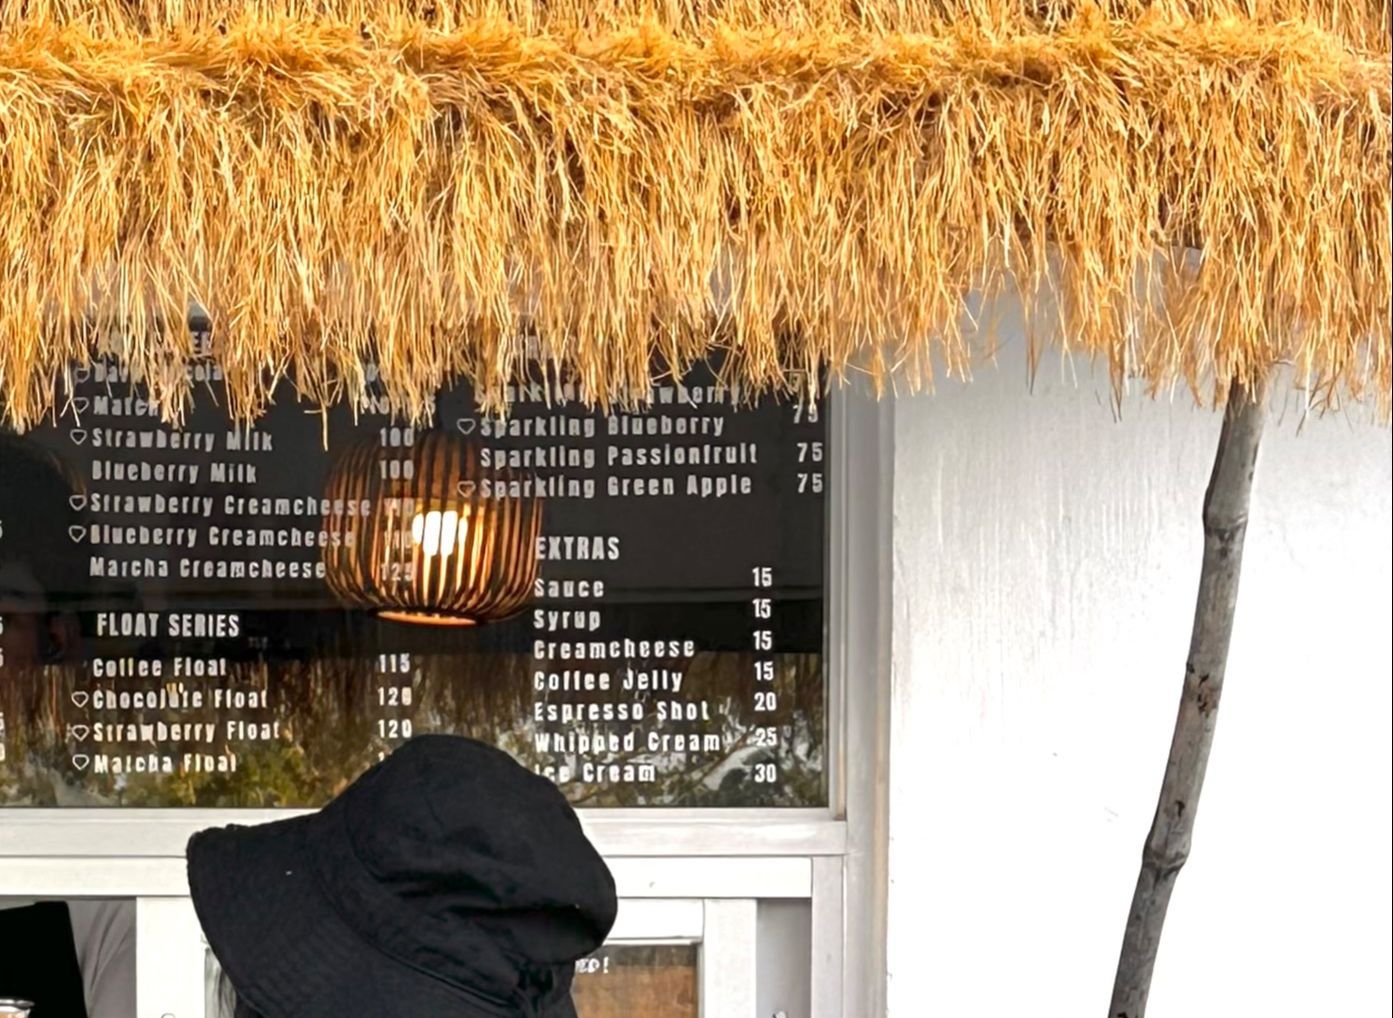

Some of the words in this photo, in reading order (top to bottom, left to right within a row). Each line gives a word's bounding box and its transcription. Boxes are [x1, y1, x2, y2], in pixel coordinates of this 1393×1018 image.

[480, 416, 595, 437] Sparkling
[608, 414, 724, 436] Blueberry
[92, 429, 214, 452] Strawberry
[226, 432, 272, 452] Milk
[380, 427, 414, 446] 100
[480, 448, 595, 468] Sparkling
[608, 444, 758, 466] Passionfruit
[797, 443, 824, 462] 75
[92, 461, 198, 484] Blueberry
[210, 464, 257, 483] Milk
[379, 459, 414, 480] 100
[479, 479, 595, 499] Sparkling
[608, 476, 674, 496] Green
[687, 475, 752, 497] Apple
[797, 473, 824, 493] 75
[90, 494, 213, 516] Strawberry
[224, 496, 371, 516] Creamcheese
[90, 525, 196, 547] Blueberry
[209, 527, 354, 547] Creamcheese
[536, 536, 620, 560] EXTRAS
[90, 557, 168, 577] Matcha
[180, 559, 326, 578] Creamcheese
[534, 578, 604, 598] Sauce
[752, 568, 772, 587] 15
[97, 614, 158, 636] FLOAT
[168, 614, 240, 637] SERIES
[534, 609, 600, 631] Syrup
[753, 600, 771, 619] 15
[534, 640, 695, 659] Creamcheese
[753, 631, 772, 650] 15
[93, 659, 161, 677] Coffee
[174, 658, 226, 676] Float
[379, 654, 410, 672] 115
[534, 670, 610, 691] Coffee
[622, 669, 683, 693] Jelly
[754, 662, 774, 681] 15
[93, 689, 202, 709] Chocolate
[214, 689, 267, 707] Float
[378, 687, 412, 706] 120
[534, 702, 643, 723] Espresso
[657, 702, 708, 721] Shot
[754, 693, 776, 711] 20
[93, 722, 214, 743] Strawberry
[227, 721, 279, 739] Float
[378, 719, 412, 738] 120
[534, 733, 634, 755] Whipped
[648, 732, 720, 751] Cream
[755, 728, 777, 746] 25
[95, 754, 172, 773] Matcha
[184, 753, 236, 772] Float
[583, 763, 655, 782] Cream
[754, 764, 776, 783] 30
